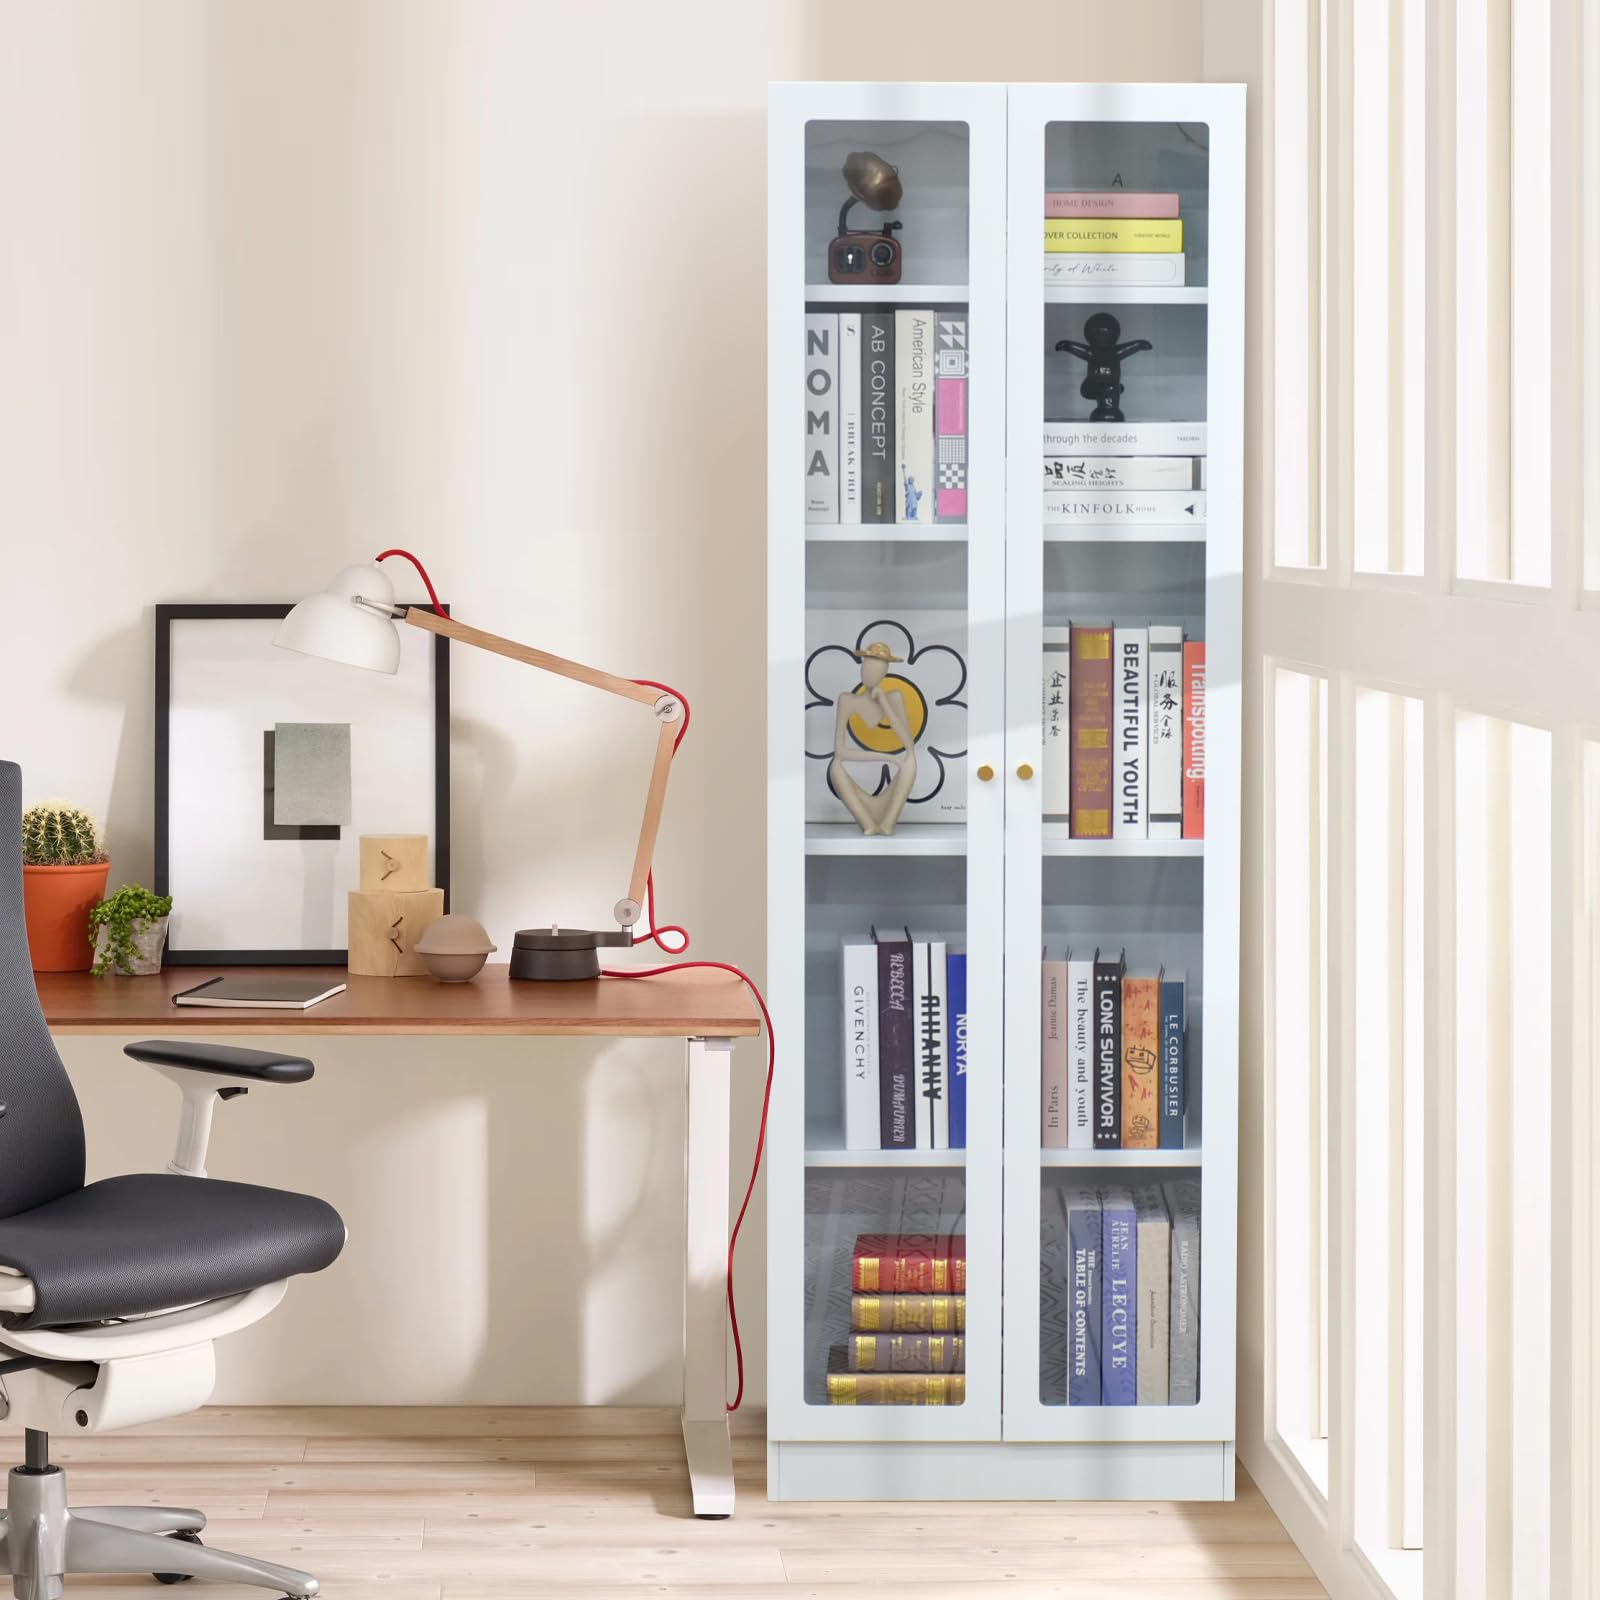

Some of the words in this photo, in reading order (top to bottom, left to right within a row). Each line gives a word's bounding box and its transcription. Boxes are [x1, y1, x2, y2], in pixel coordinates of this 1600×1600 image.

[1052, 199, 1079, 209] HOME
[1081, 199, 1115, 209] DESIGN
[1066, 231, 1119, 240] COLLECTION
[871, 325, 886, 353] AB
[911, 318, 927, 379] American
[806, 329, 832, 477] NOMA
[871, 360, 886, 460] CONCEPT
[908, 382, 927, 414] Style
[847, 421, 856, 466] BREAK
[1043, 433, 1080, 446] through
[1083, 433, 1098, 444] the
[1100, 433, 1138, 444] decades
[1052, 479, 1087, 487] SCALING
[1088, 479, 1125, 487] HEIGHTS
[1062, 503, 1136, 514] KINFOLK
[1122, 643, 1139, 751] BEAUTIFUL
[1122, 758, 1139, 825] YOUTH
[889, 952, 905, 1011] REBECCA
[1048, 976, 1058, 1008] Damas
[1077, 979, 1089, 1004] The
[1048, 1009, 1058, 1040] Jeanne
[1100, 990, 1114, 1035] LONE
[1169, 1014, 1179, 1030] LE
[853, 985, 866, 1080] GIVENCHY
[1074, 1008, 1089, 1054] beauty
[1077, 1058, 1089, 1083] and
[1100, 1038, 1114, 1128] SURVIVOR
[1169, 1037, 1179, 1117] CORBUSIER
[1048, 1085, 1059, 1113] Paris
[1074, 1088, 1089, 1127] youth
[1048, 1114, 1059, 1128] In
[1111, 1219, 1120, 1271] AURELIE
[1120, 1221, 1129, 1250] JEAN
[1075, 1248, 1087, 1287] TABLE
[1087, 1250, 1096, 1269] THE
[1075, 1290, 1086, 1308] OF
[1111, 1279, 1128, 1369] LECUYE
[1075, 1310, 1086, 1377] CONTENTS
